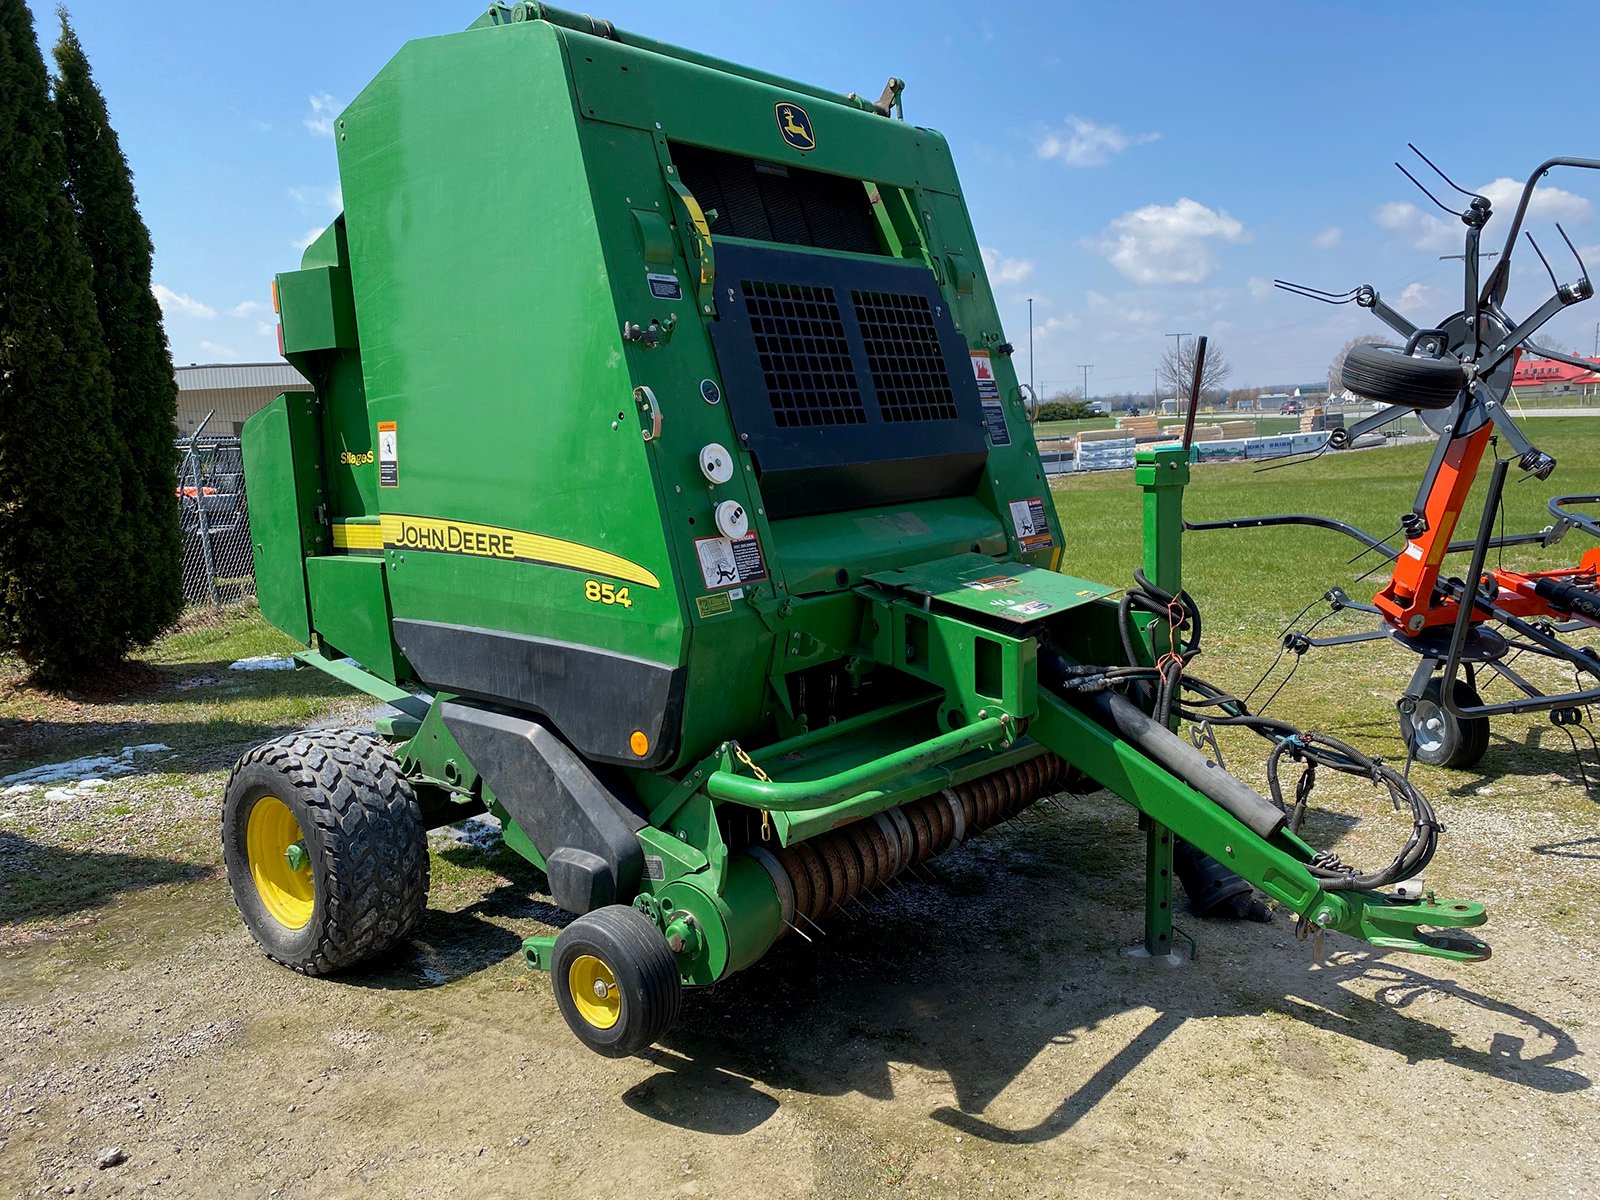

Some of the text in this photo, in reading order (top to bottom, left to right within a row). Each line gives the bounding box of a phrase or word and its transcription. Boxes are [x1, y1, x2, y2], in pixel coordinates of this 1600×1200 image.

[396, 521, 514, 555] JOHN DEERE
[585, 579, 633, 609] 854
